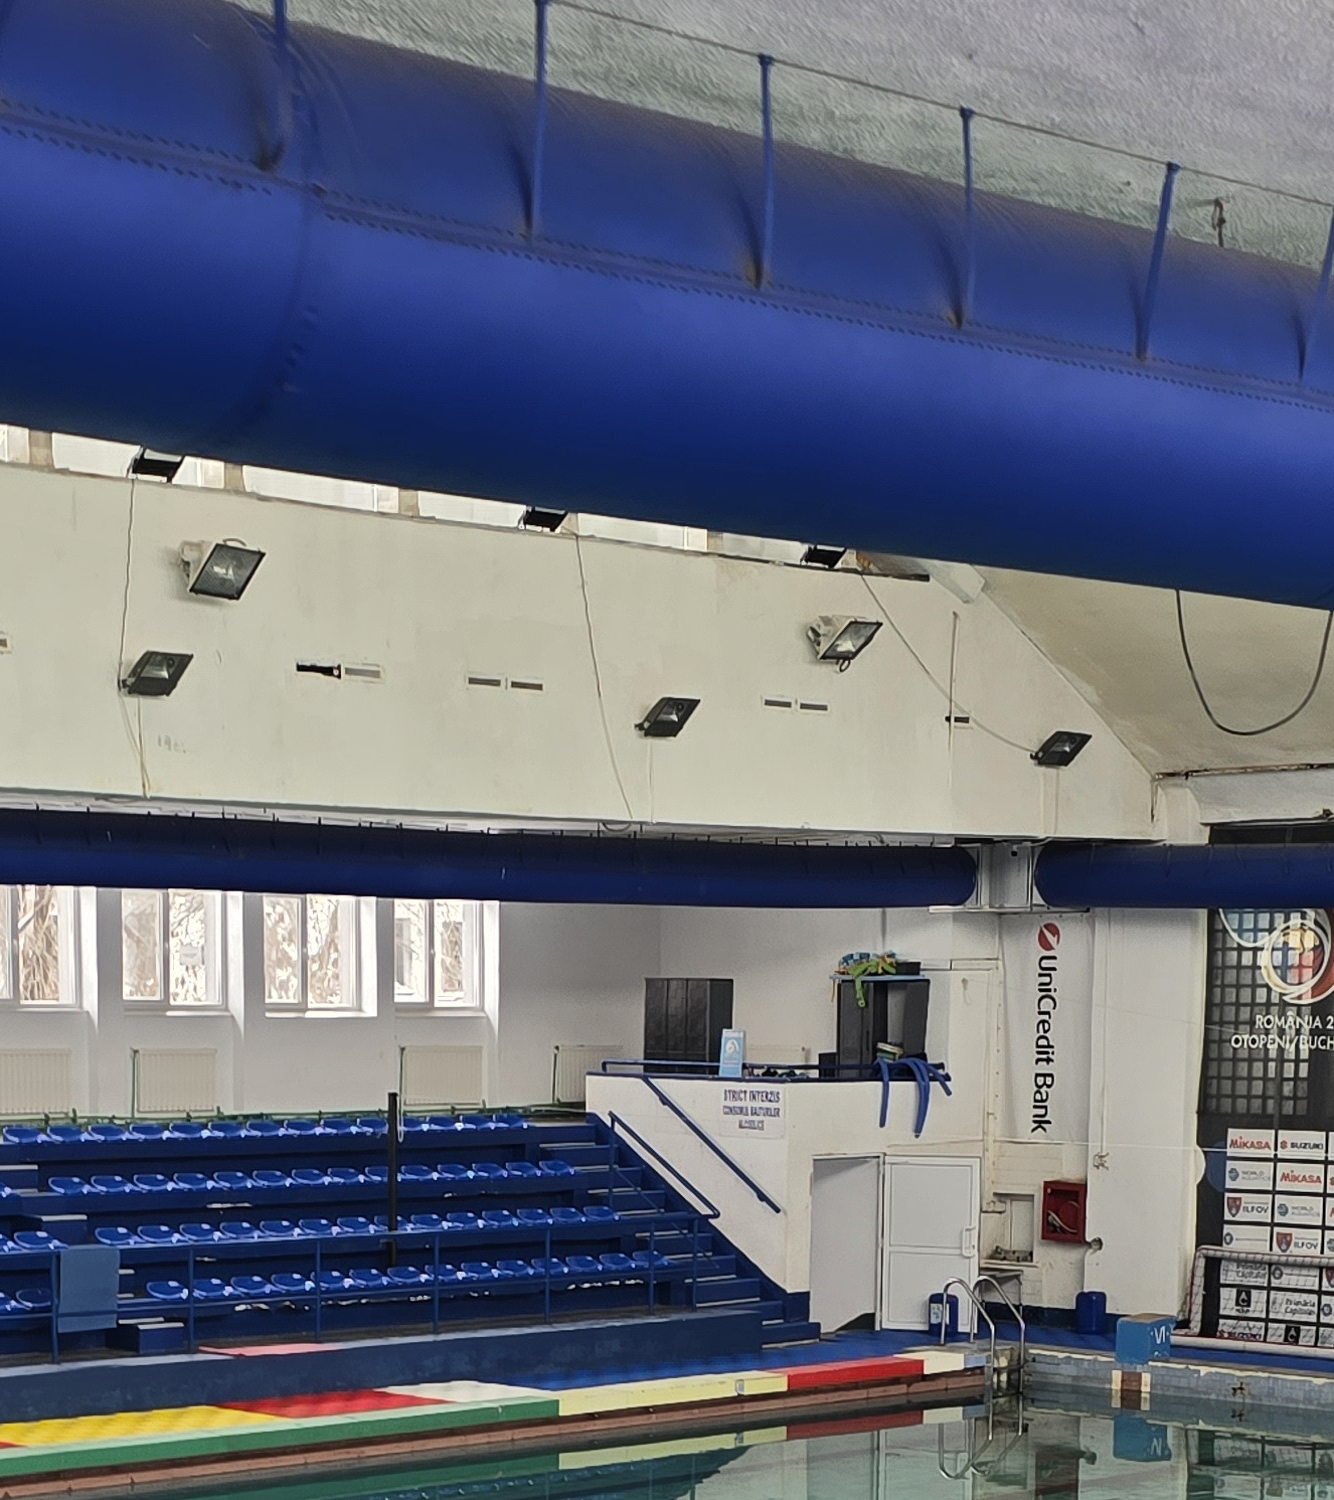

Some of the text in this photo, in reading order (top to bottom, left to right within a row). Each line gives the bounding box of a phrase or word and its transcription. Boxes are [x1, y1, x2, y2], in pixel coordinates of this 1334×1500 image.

[1256, 1011, 1322, 1031] ROMÂNIA
[1031, 955, 1057, 1134] UniCredit Bank
[1290, 1142, 1324, 1150] SUZUKI
[1242, 1206, 1269, 1214] ILFOV
[1293, 1241, 1319, 1250] ILFOV
